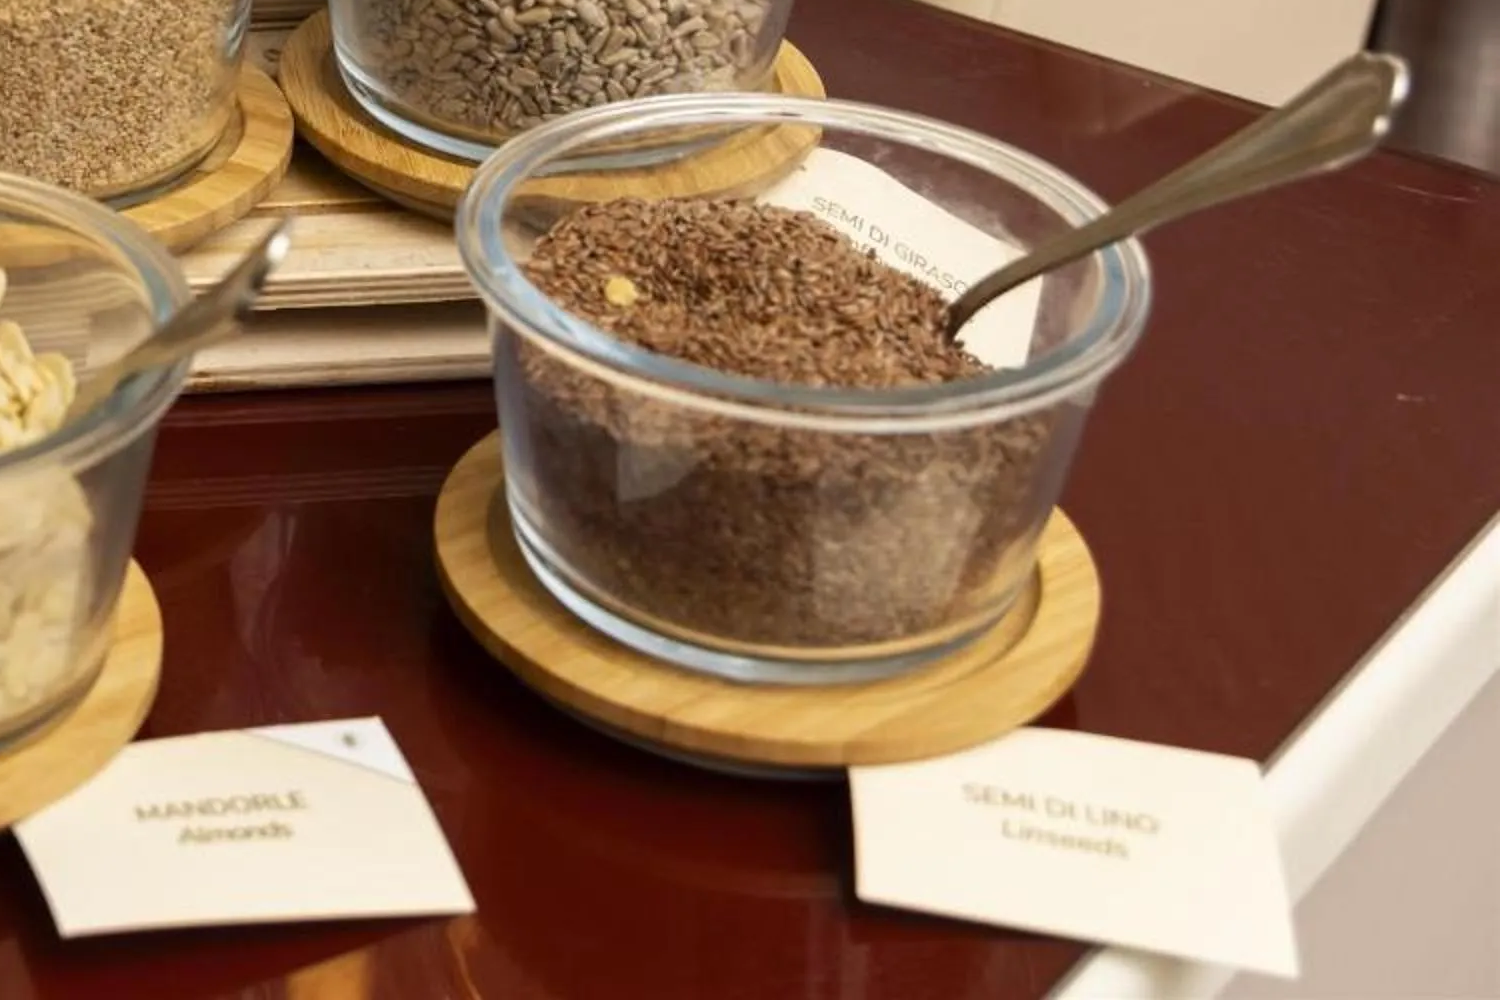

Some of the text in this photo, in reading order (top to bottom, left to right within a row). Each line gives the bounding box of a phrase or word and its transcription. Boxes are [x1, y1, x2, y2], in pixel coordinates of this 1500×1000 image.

[811, 196, 864, 233] SEMI
[868, 224, 890, 248] DI
[893, 240, 969, 297] GIRASO
[134, 789, 309, 822] MANDORLE
[961, 782, 1160, 835] SEMI DI LINO
[176, 820, 293, 845] Almonds
[1001, 818, 1130, 859] Linseeds
